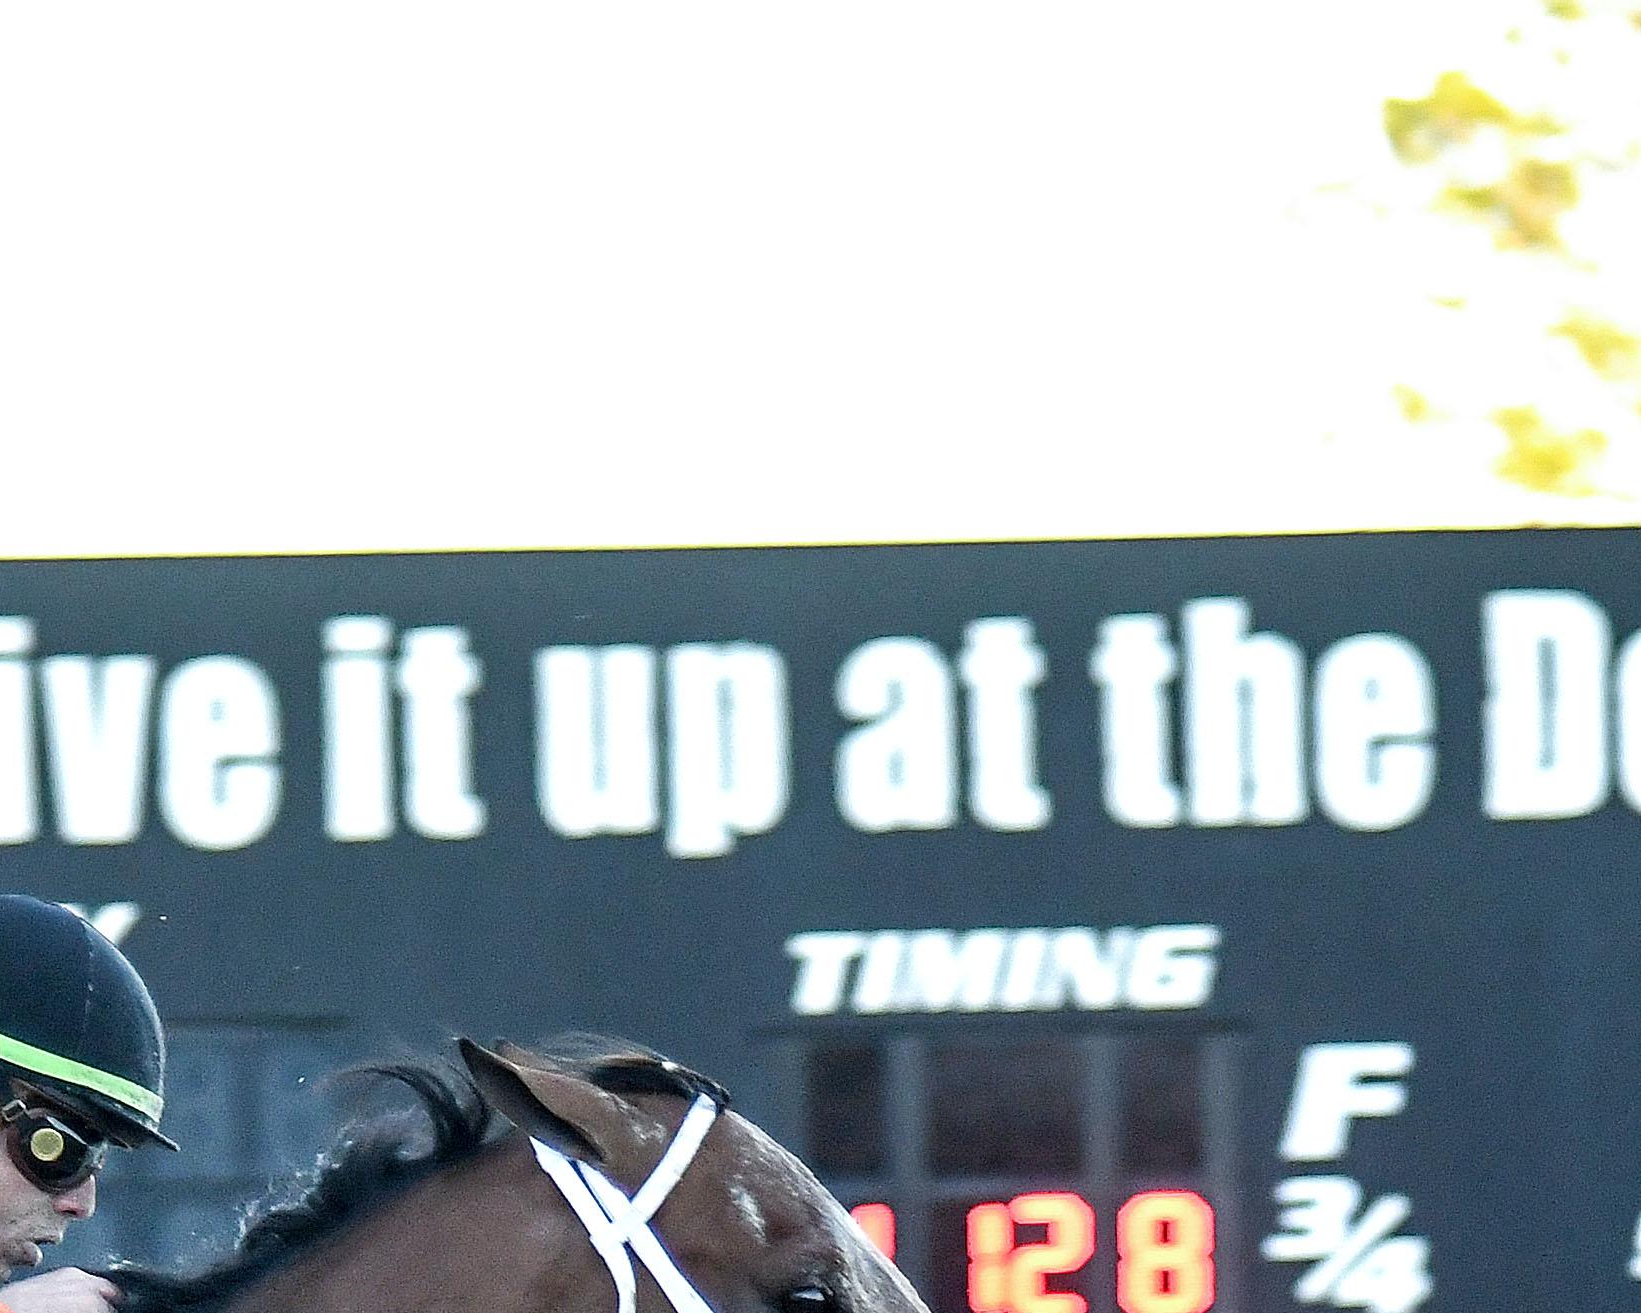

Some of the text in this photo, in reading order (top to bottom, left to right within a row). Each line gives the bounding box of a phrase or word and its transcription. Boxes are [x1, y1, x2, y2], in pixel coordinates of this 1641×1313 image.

[321, 614, 486, 843] it
[535, 641, 790, 860] up
[836, 616, 1052, 834] at
[1090, 596, 1437, 834] the
[1481, 588, 1641, 821] D
[785, 922, 1221, 1016] TIMING
[1278, 1041, 1414, 1162] F
